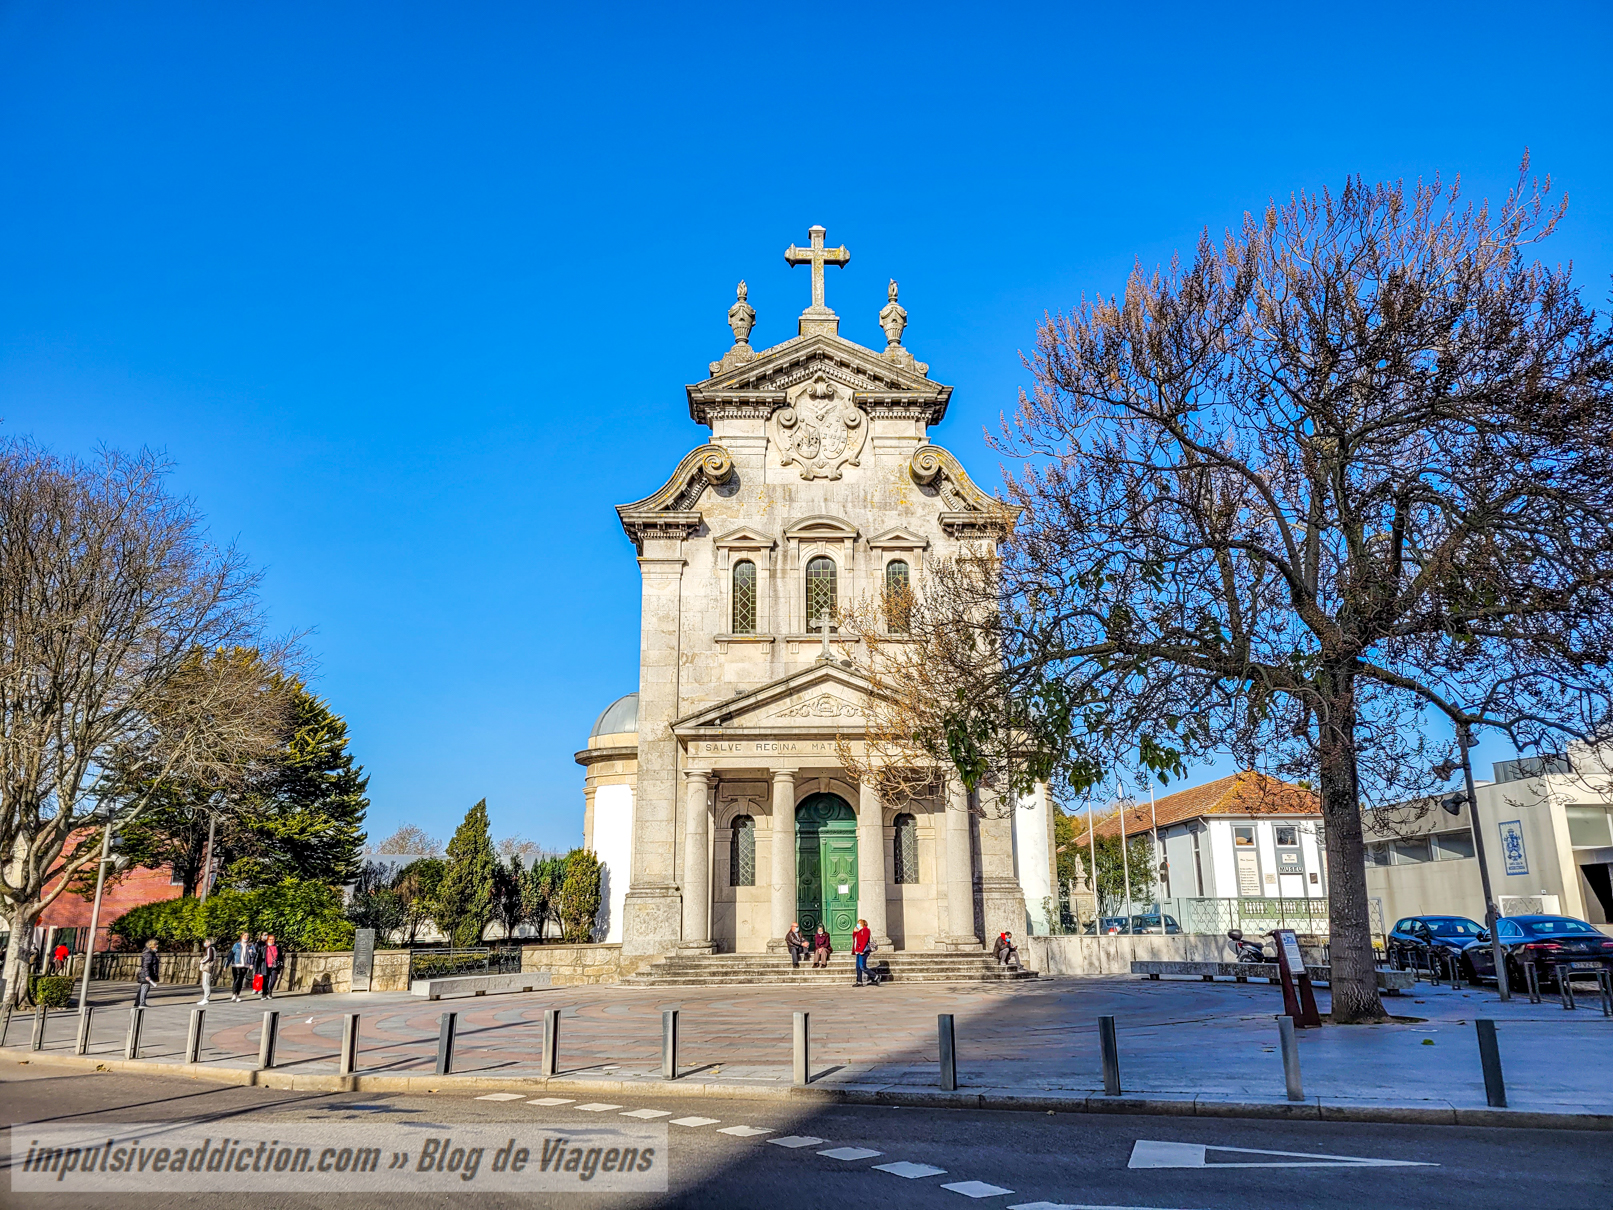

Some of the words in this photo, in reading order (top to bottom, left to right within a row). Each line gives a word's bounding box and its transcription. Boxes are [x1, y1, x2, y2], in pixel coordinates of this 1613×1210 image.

[705, 743, 742, 751] SALVE
[755, 743, 797, 751] REGINA
[811, 743, 850, 751] MAT
